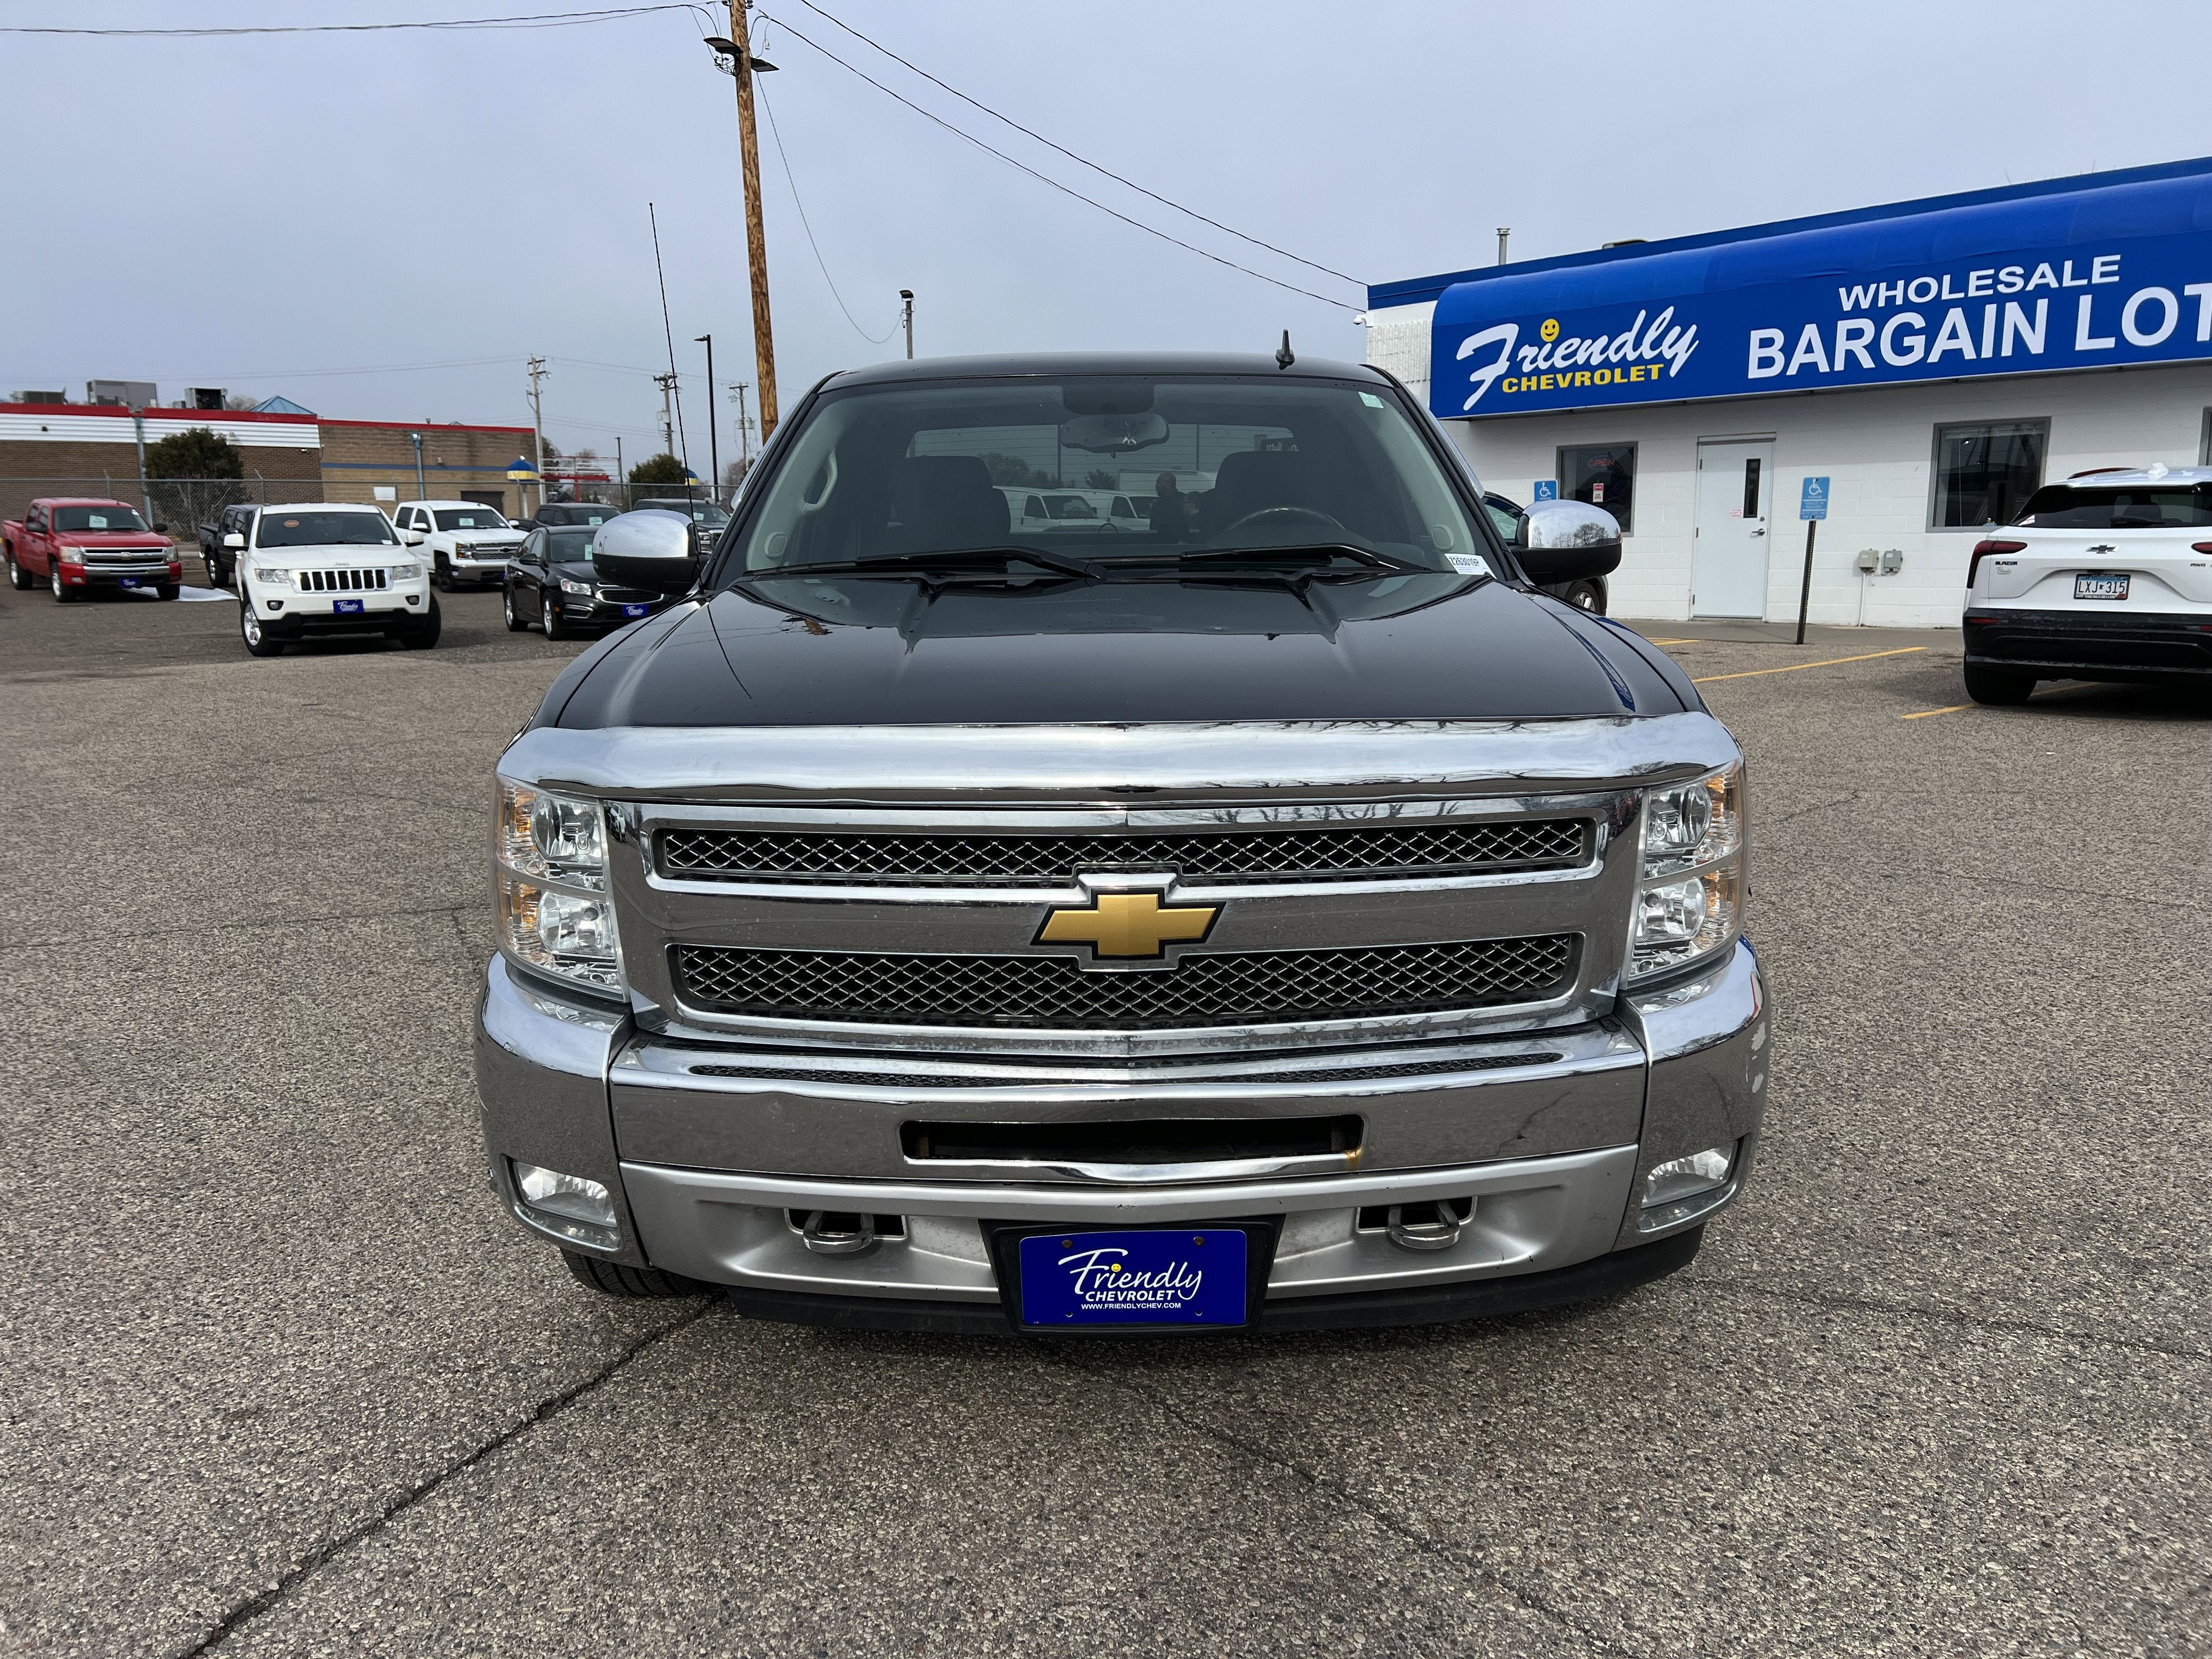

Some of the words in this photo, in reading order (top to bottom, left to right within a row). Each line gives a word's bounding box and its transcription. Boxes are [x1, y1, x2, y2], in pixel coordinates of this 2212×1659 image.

[1838, 254, 2121, 312] WHOLESALE
[1748, 298, 2049, 380] BARGAIN
[2075, 283, 2212, 351] LOT
[1456, 306, 1699, 411] Friendly
[1502, 363, 1664, 393] CHEVROLET
[1588, 458, 1616, 467] OPEN
[2078, 581, 2098, 593] LXJ
[2105, 581, 2125, 594] 315
[1058, 1248, 1203, 1300] Friendly
[1085, 1290, 1175, 1302] CHEVROLET
